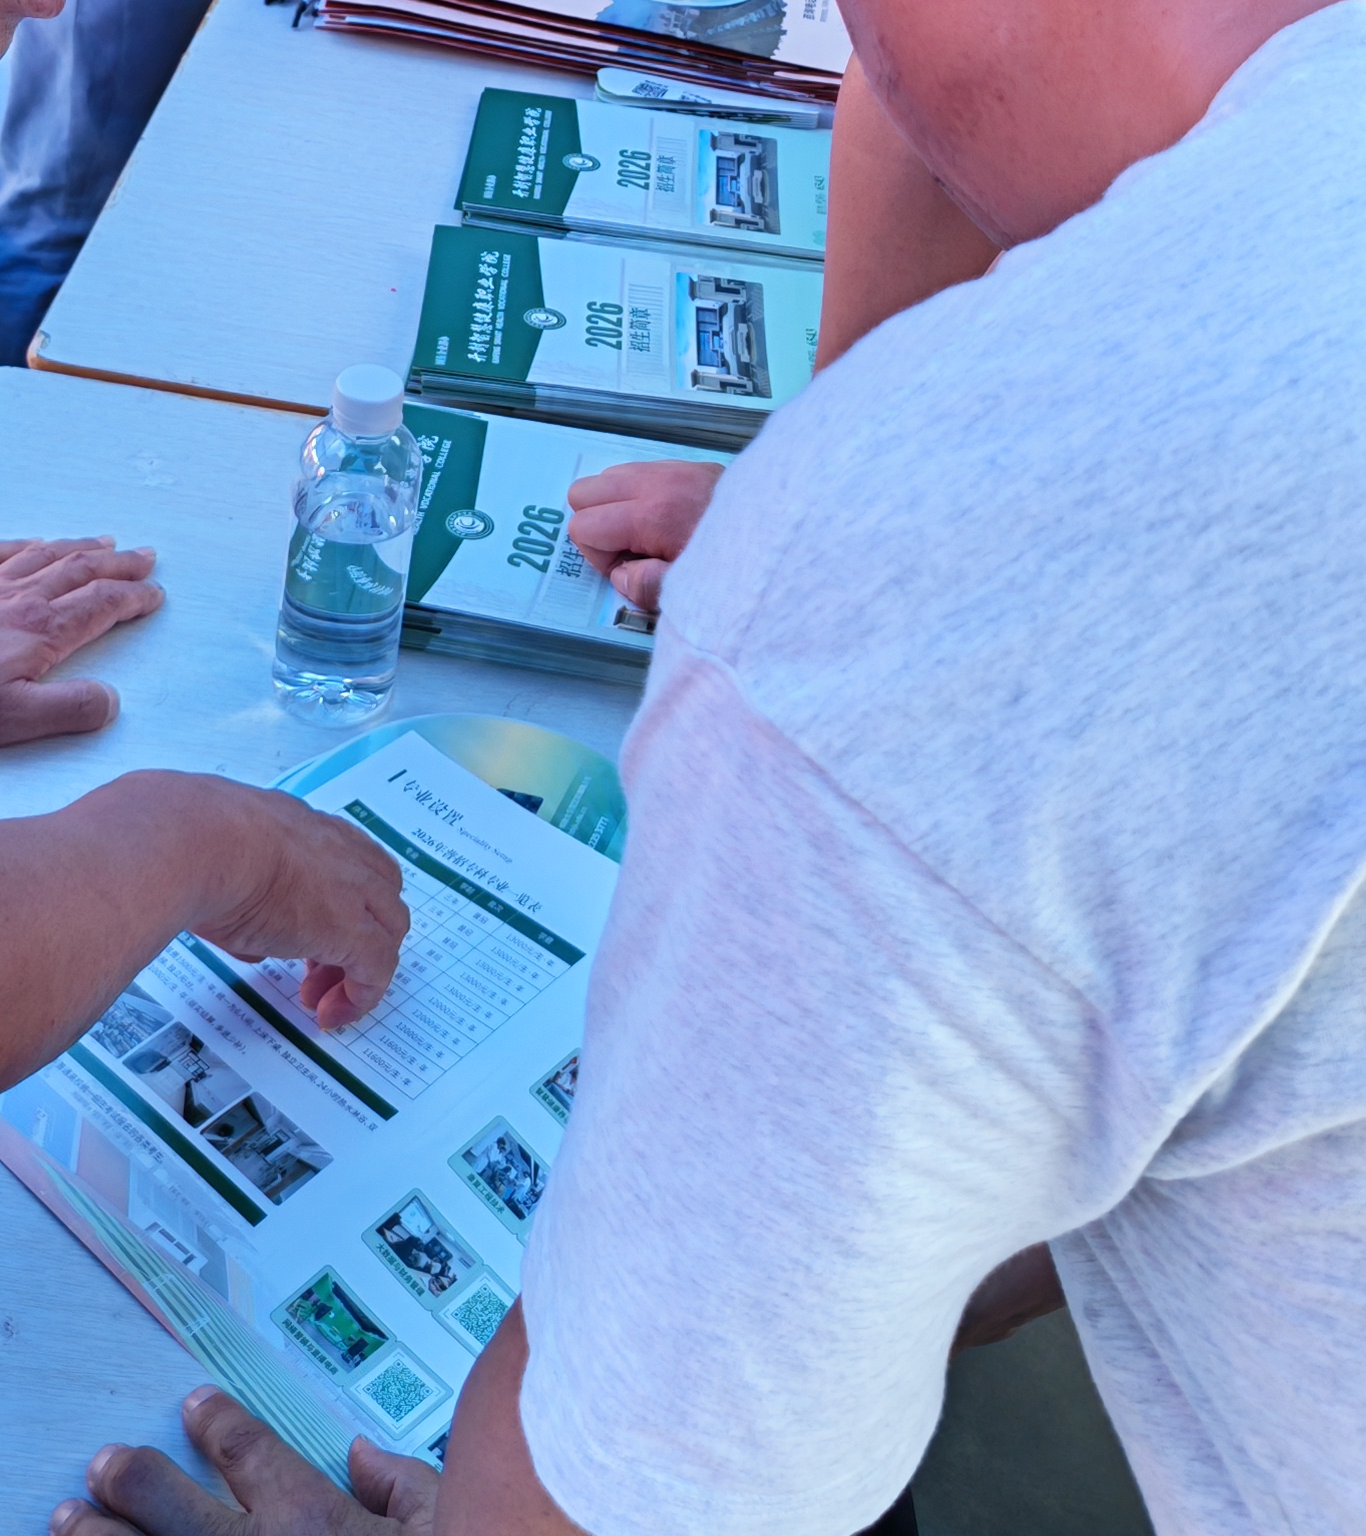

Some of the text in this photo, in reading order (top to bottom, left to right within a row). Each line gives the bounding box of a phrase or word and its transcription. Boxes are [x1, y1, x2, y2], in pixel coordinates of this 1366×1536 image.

[616, 149, 652, 191] 2026
[655, 154, 676, 193] 招生简章
[585, 301, 624, 351] 2026
[628, 306, 652, 353] 招生简章
[435, 439, 452, 469] COLLEGE
[506, 504, 565, 574] 2026
[404, 780, 462, 825] 专业设置
